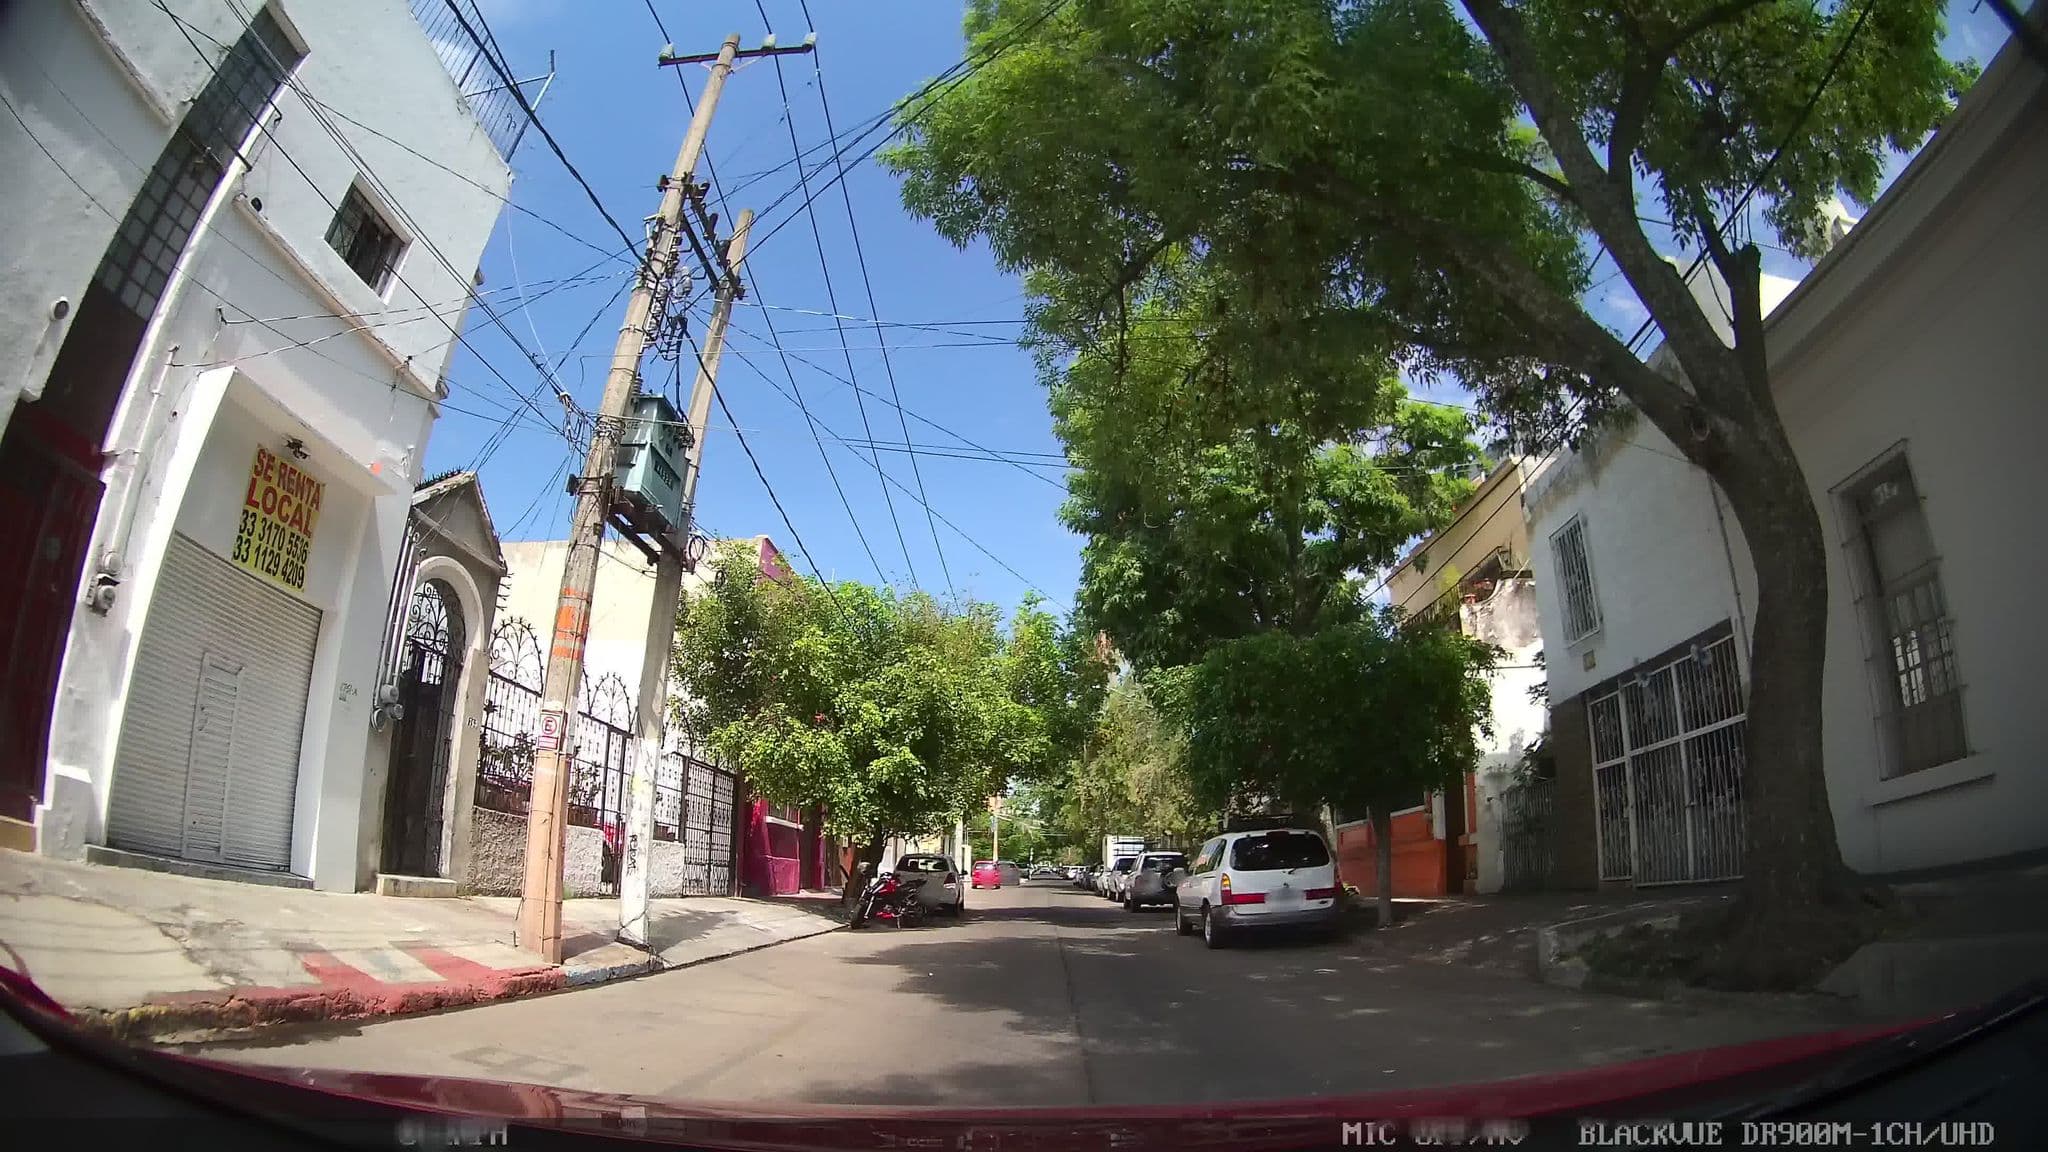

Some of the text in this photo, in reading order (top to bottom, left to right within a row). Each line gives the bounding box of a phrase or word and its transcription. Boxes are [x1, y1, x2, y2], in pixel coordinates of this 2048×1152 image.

[246, 477, 313, 538] LOCAL
[254, 449, 322, 512] SE RENTA
[239, 510, 257, 537] 33
[258, 517, 286, 551] 3170
[233, 535, 305, 589] 33 1129 4209
